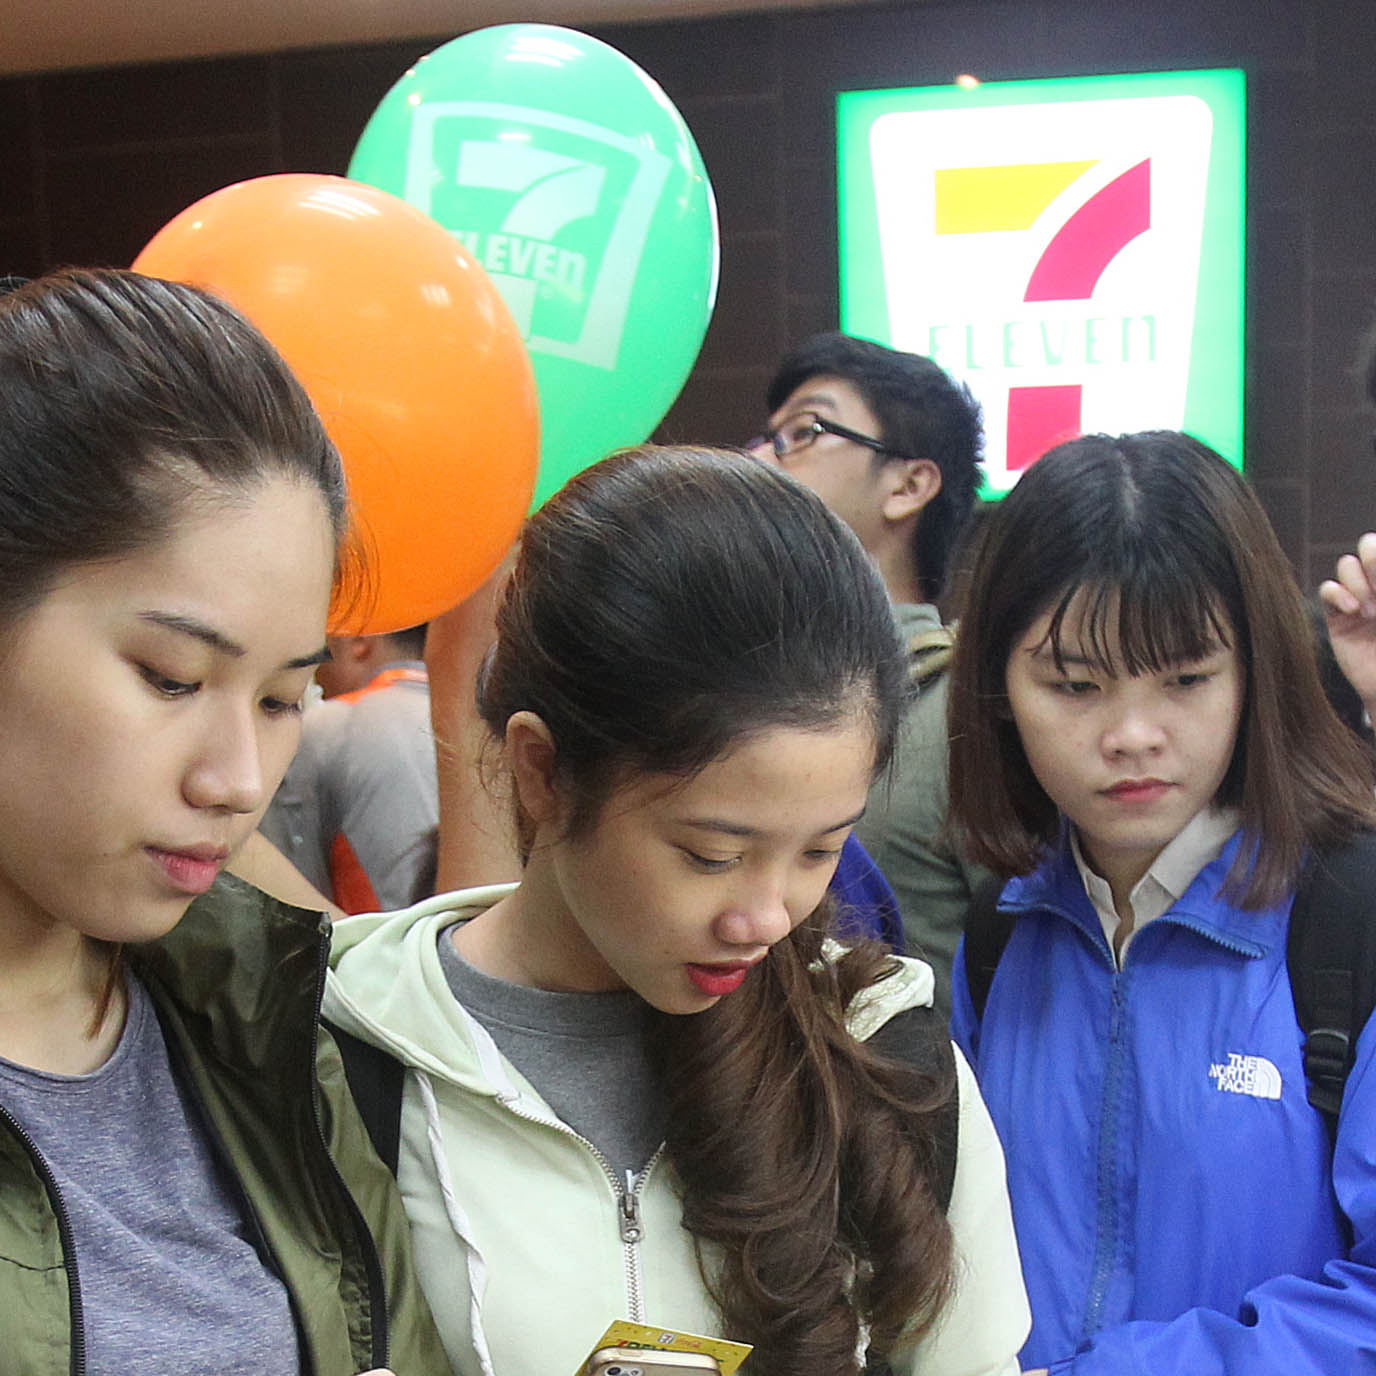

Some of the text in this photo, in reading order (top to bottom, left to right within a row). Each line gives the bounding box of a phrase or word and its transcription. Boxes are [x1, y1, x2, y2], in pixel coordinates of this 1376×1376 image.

[1228, 1053, 1257, 1071] THE
[1208, 1063, 1255, 1083] NORTH
[1217, 1077, 1256, 1095] FACE
